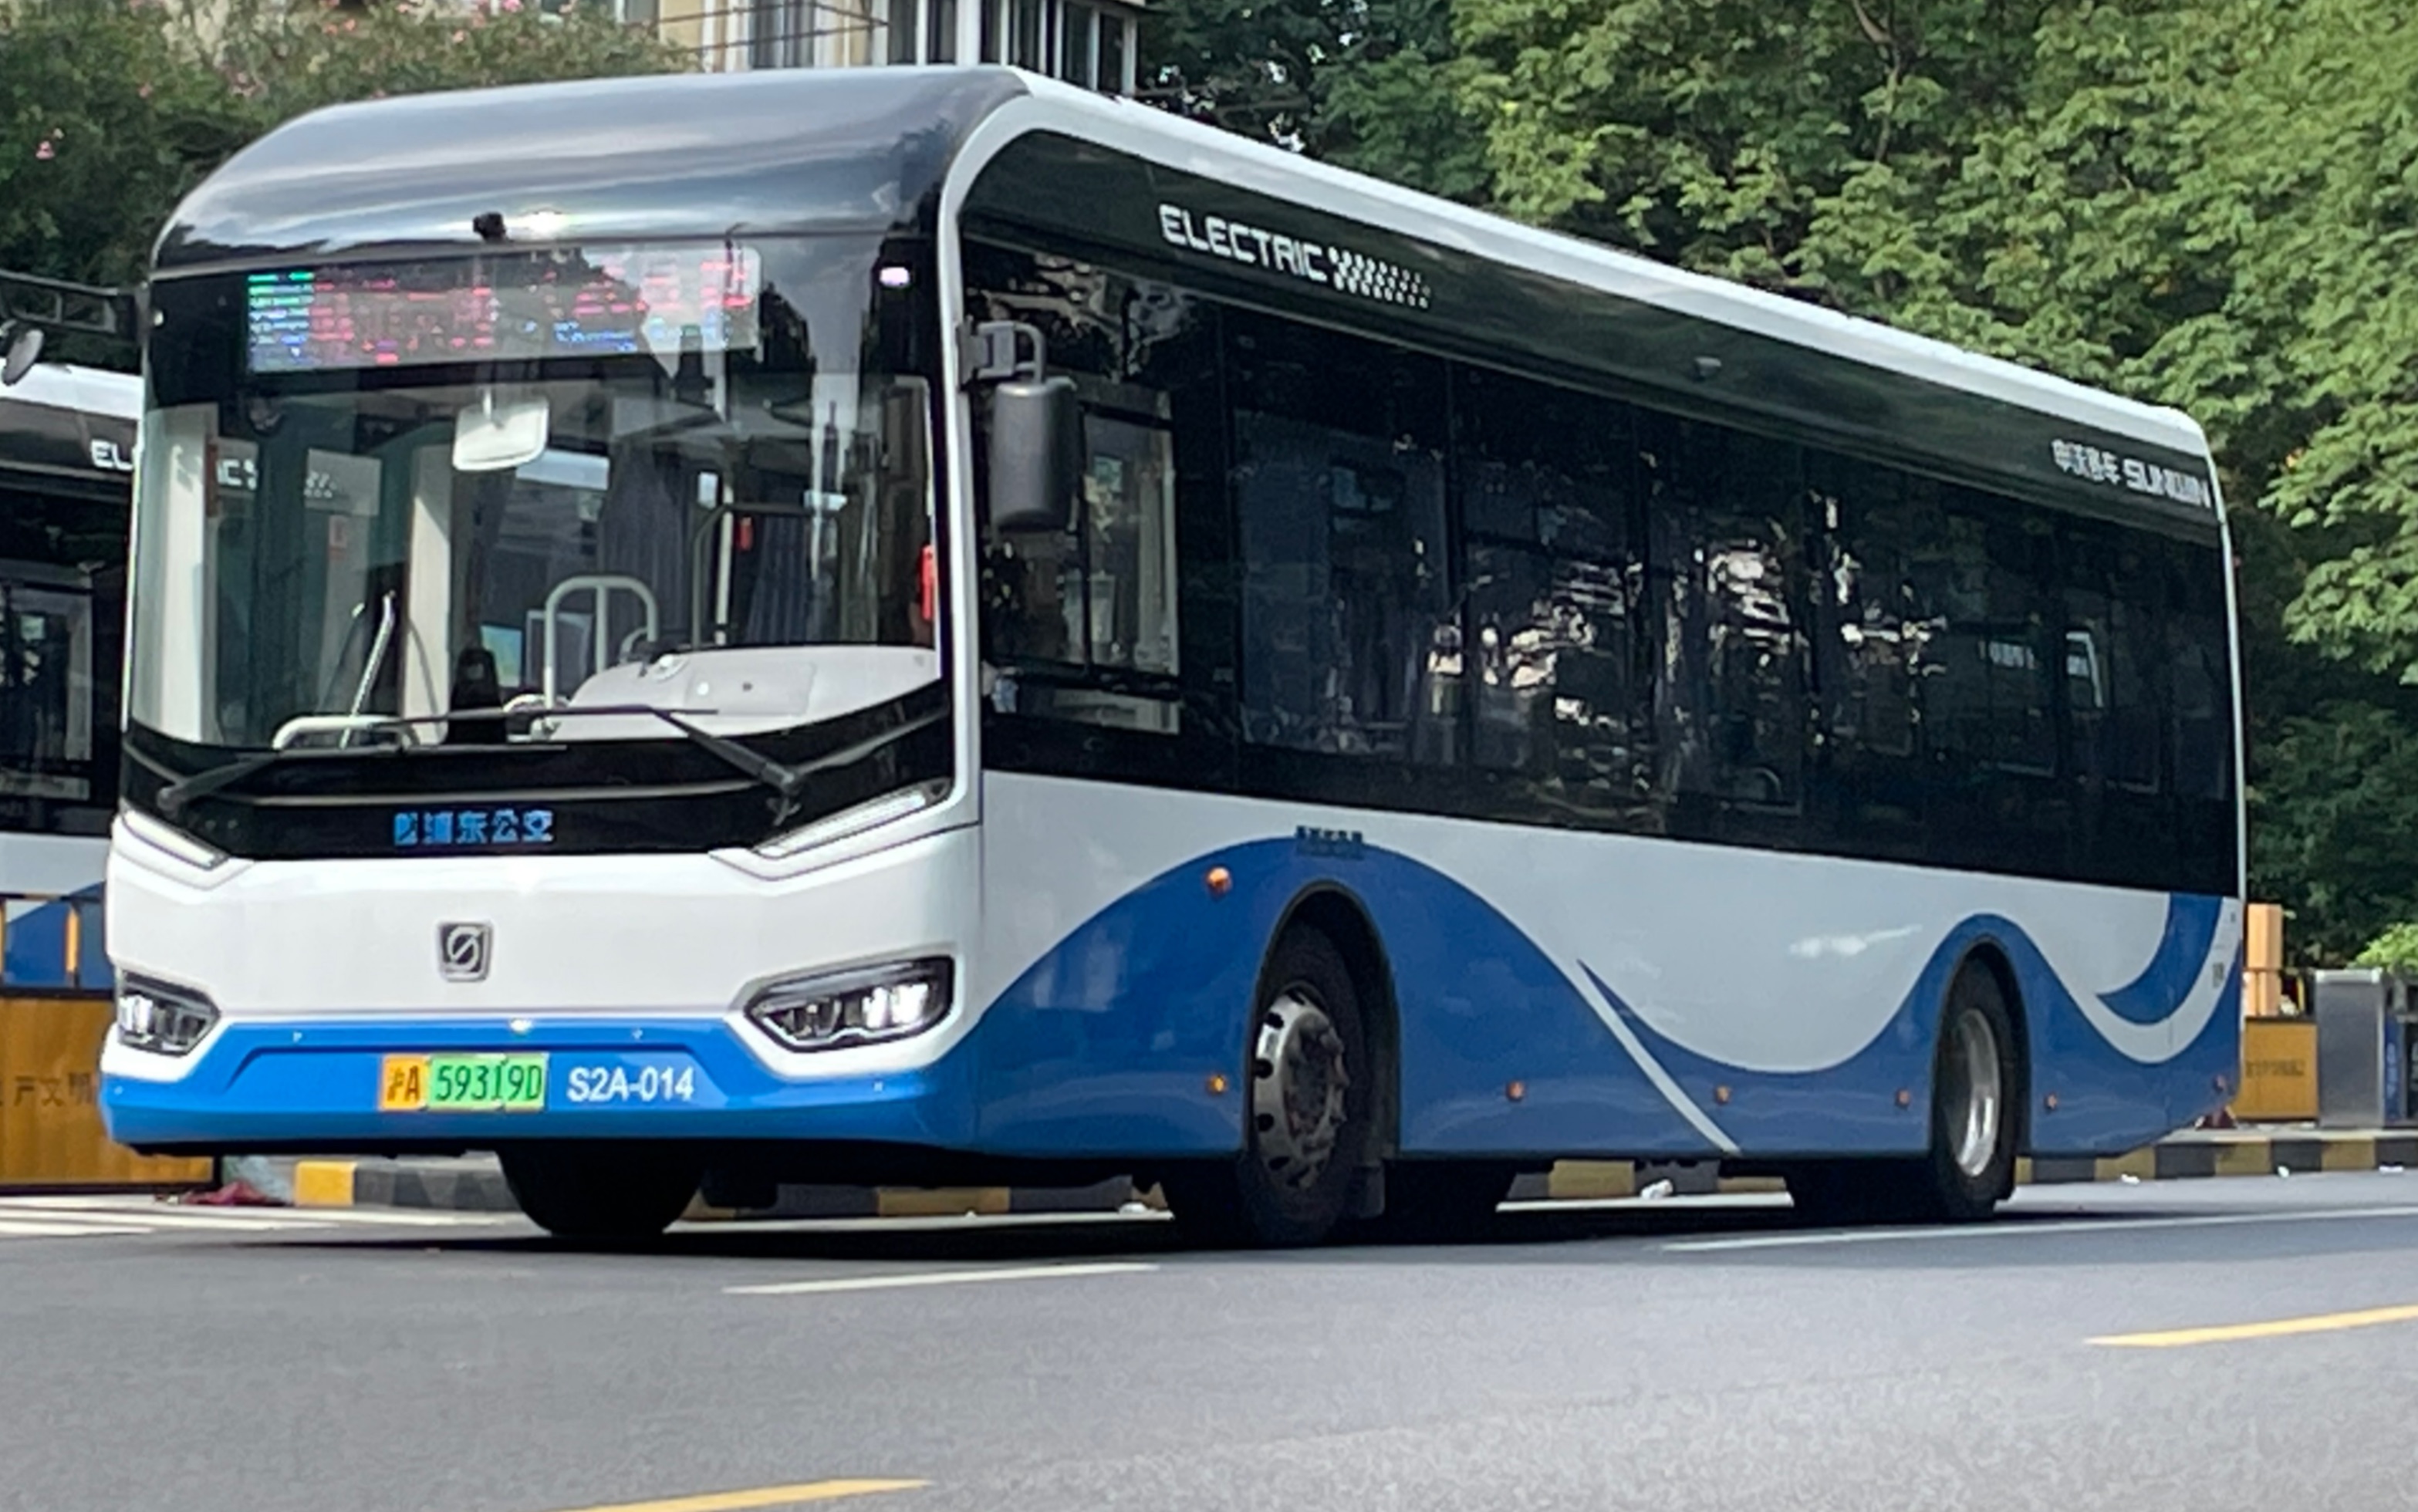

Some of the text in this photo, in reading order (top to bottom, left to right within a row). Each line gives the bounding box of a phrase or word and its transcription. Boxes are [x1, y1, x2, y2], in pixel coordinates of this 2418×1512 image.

[1159, 204, 1328, 282] ELECTRIC
[435, 1065, 542, 1102] 59319D
[567, 1066, 694, 1102] S2A-014
